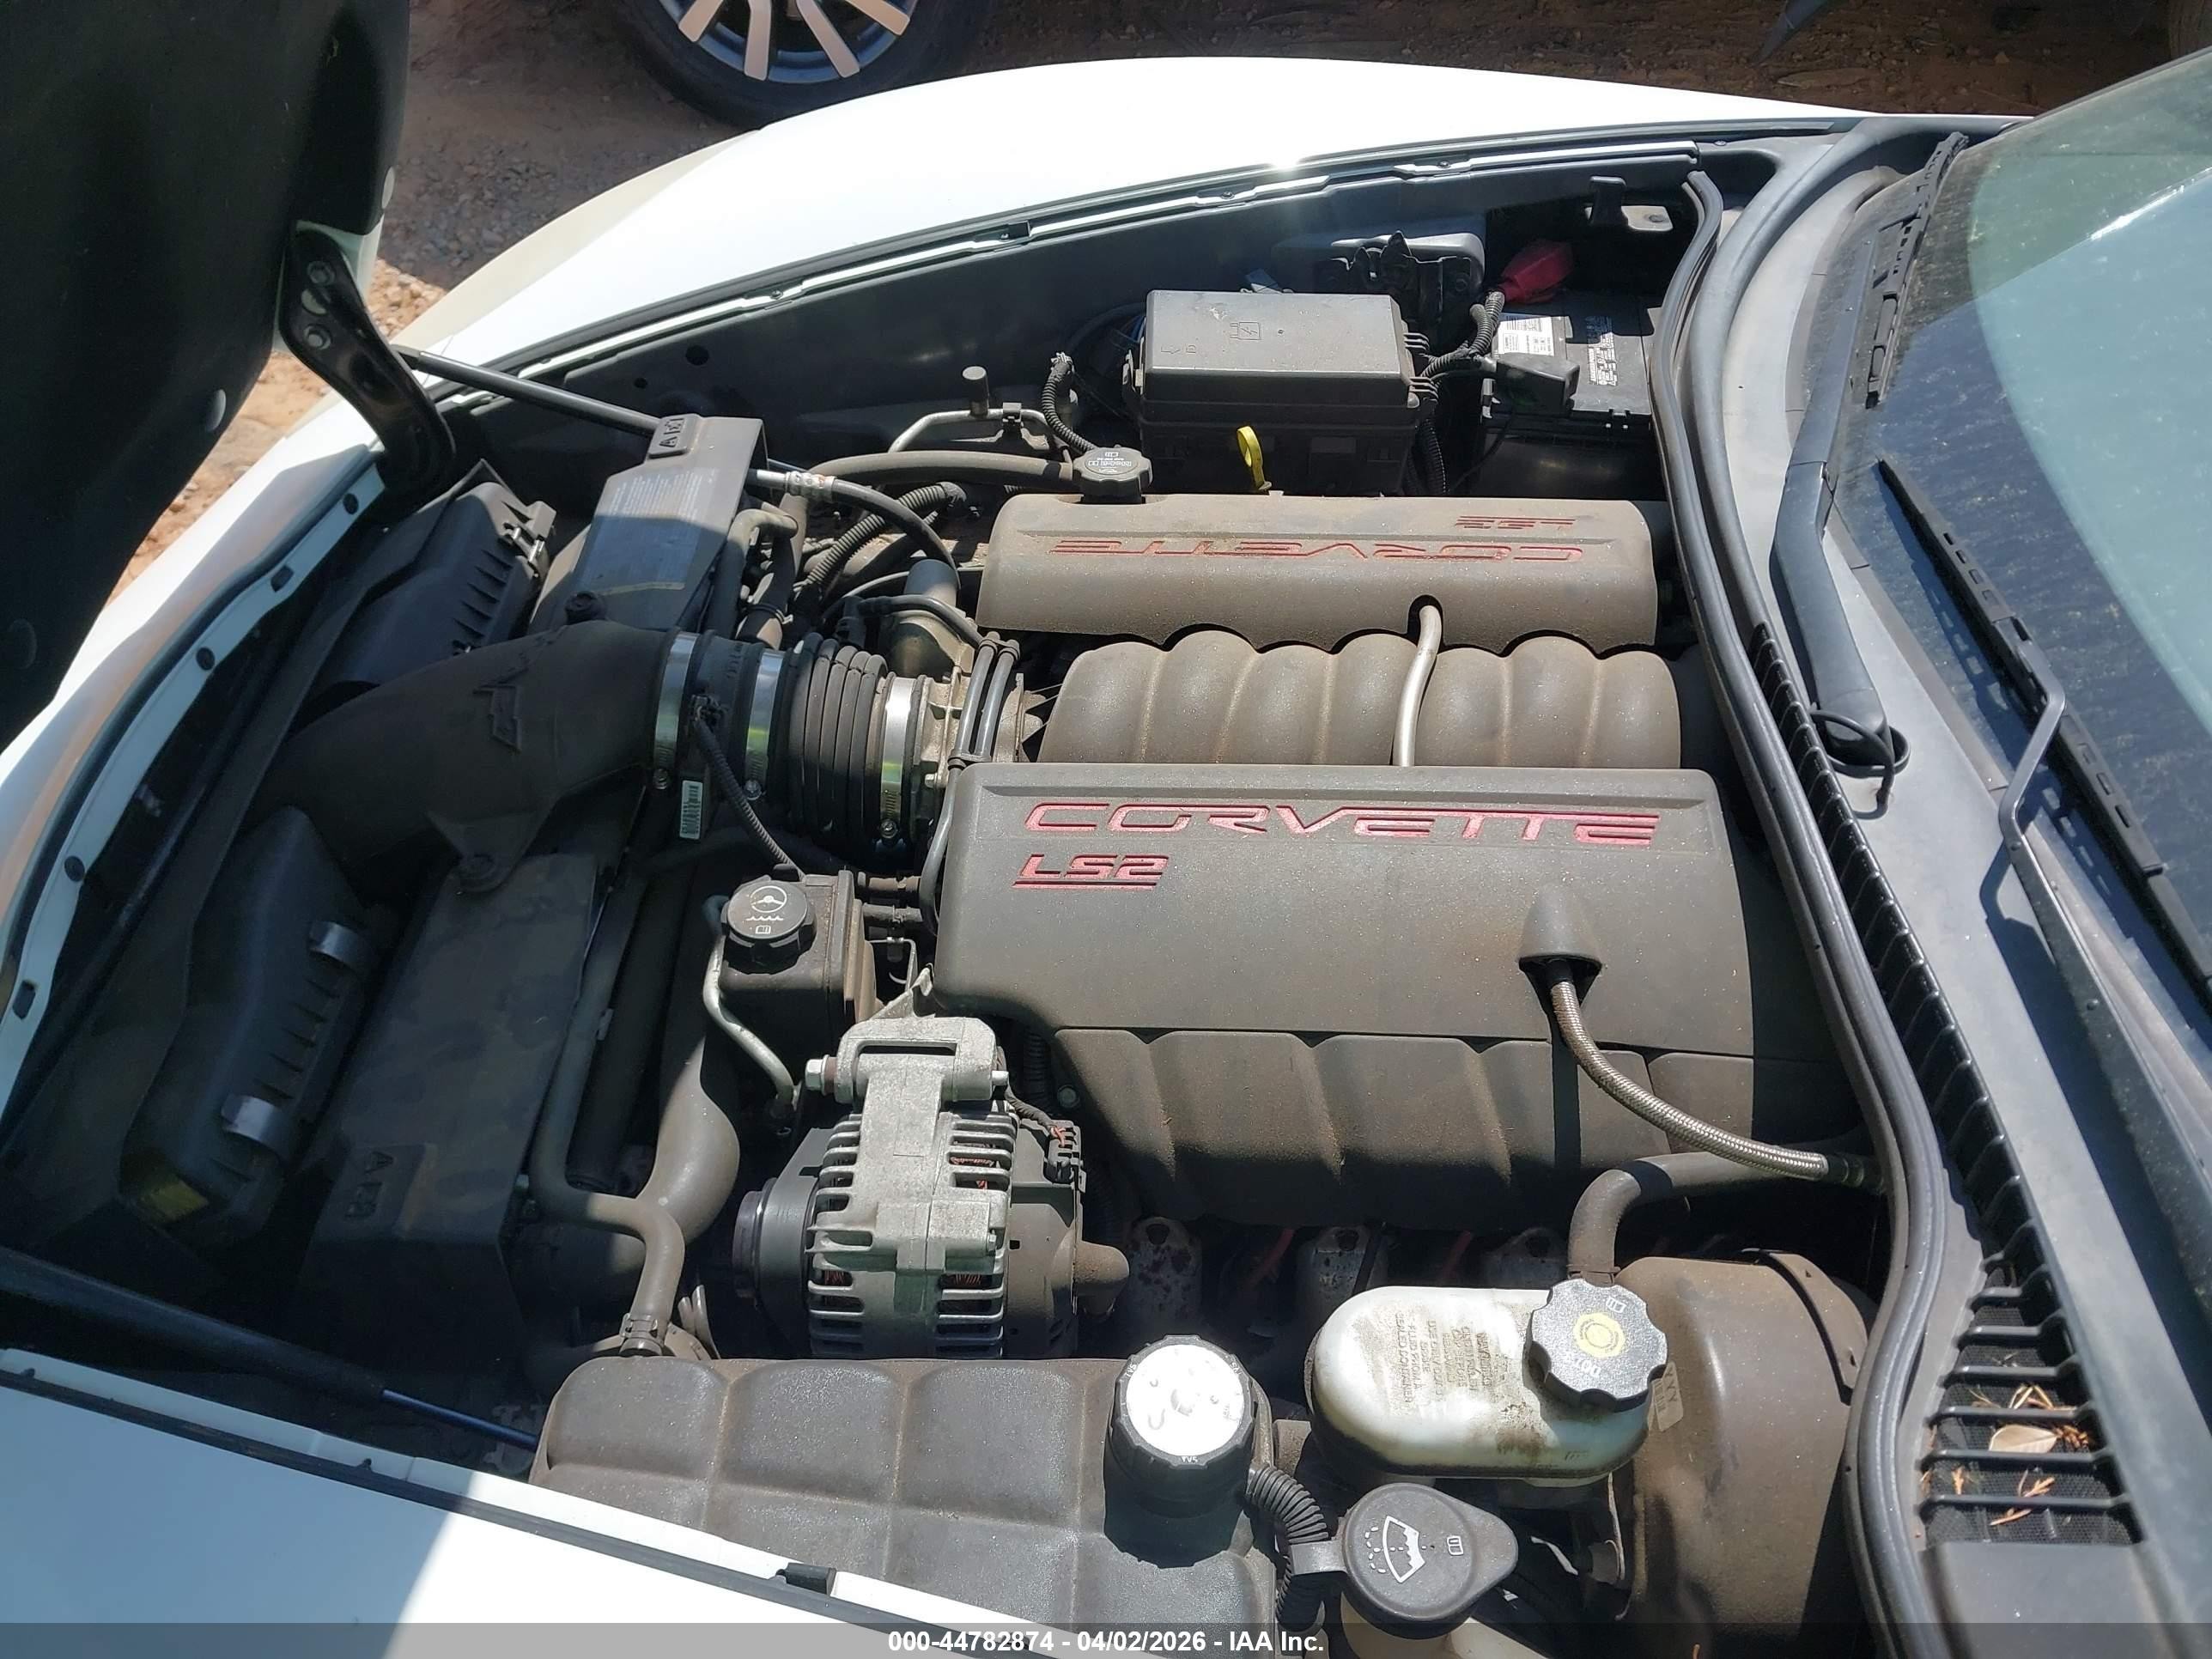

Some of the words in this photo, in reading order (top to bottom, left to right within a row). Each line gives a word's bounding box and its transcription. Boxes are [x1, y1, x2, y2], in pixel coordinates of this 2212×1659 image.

[1048, 539, 1583, 562] CORVETTE
[1024, 802, 1660, 846] CORVETTE
[1019, 854, 1169, 879] LS2
